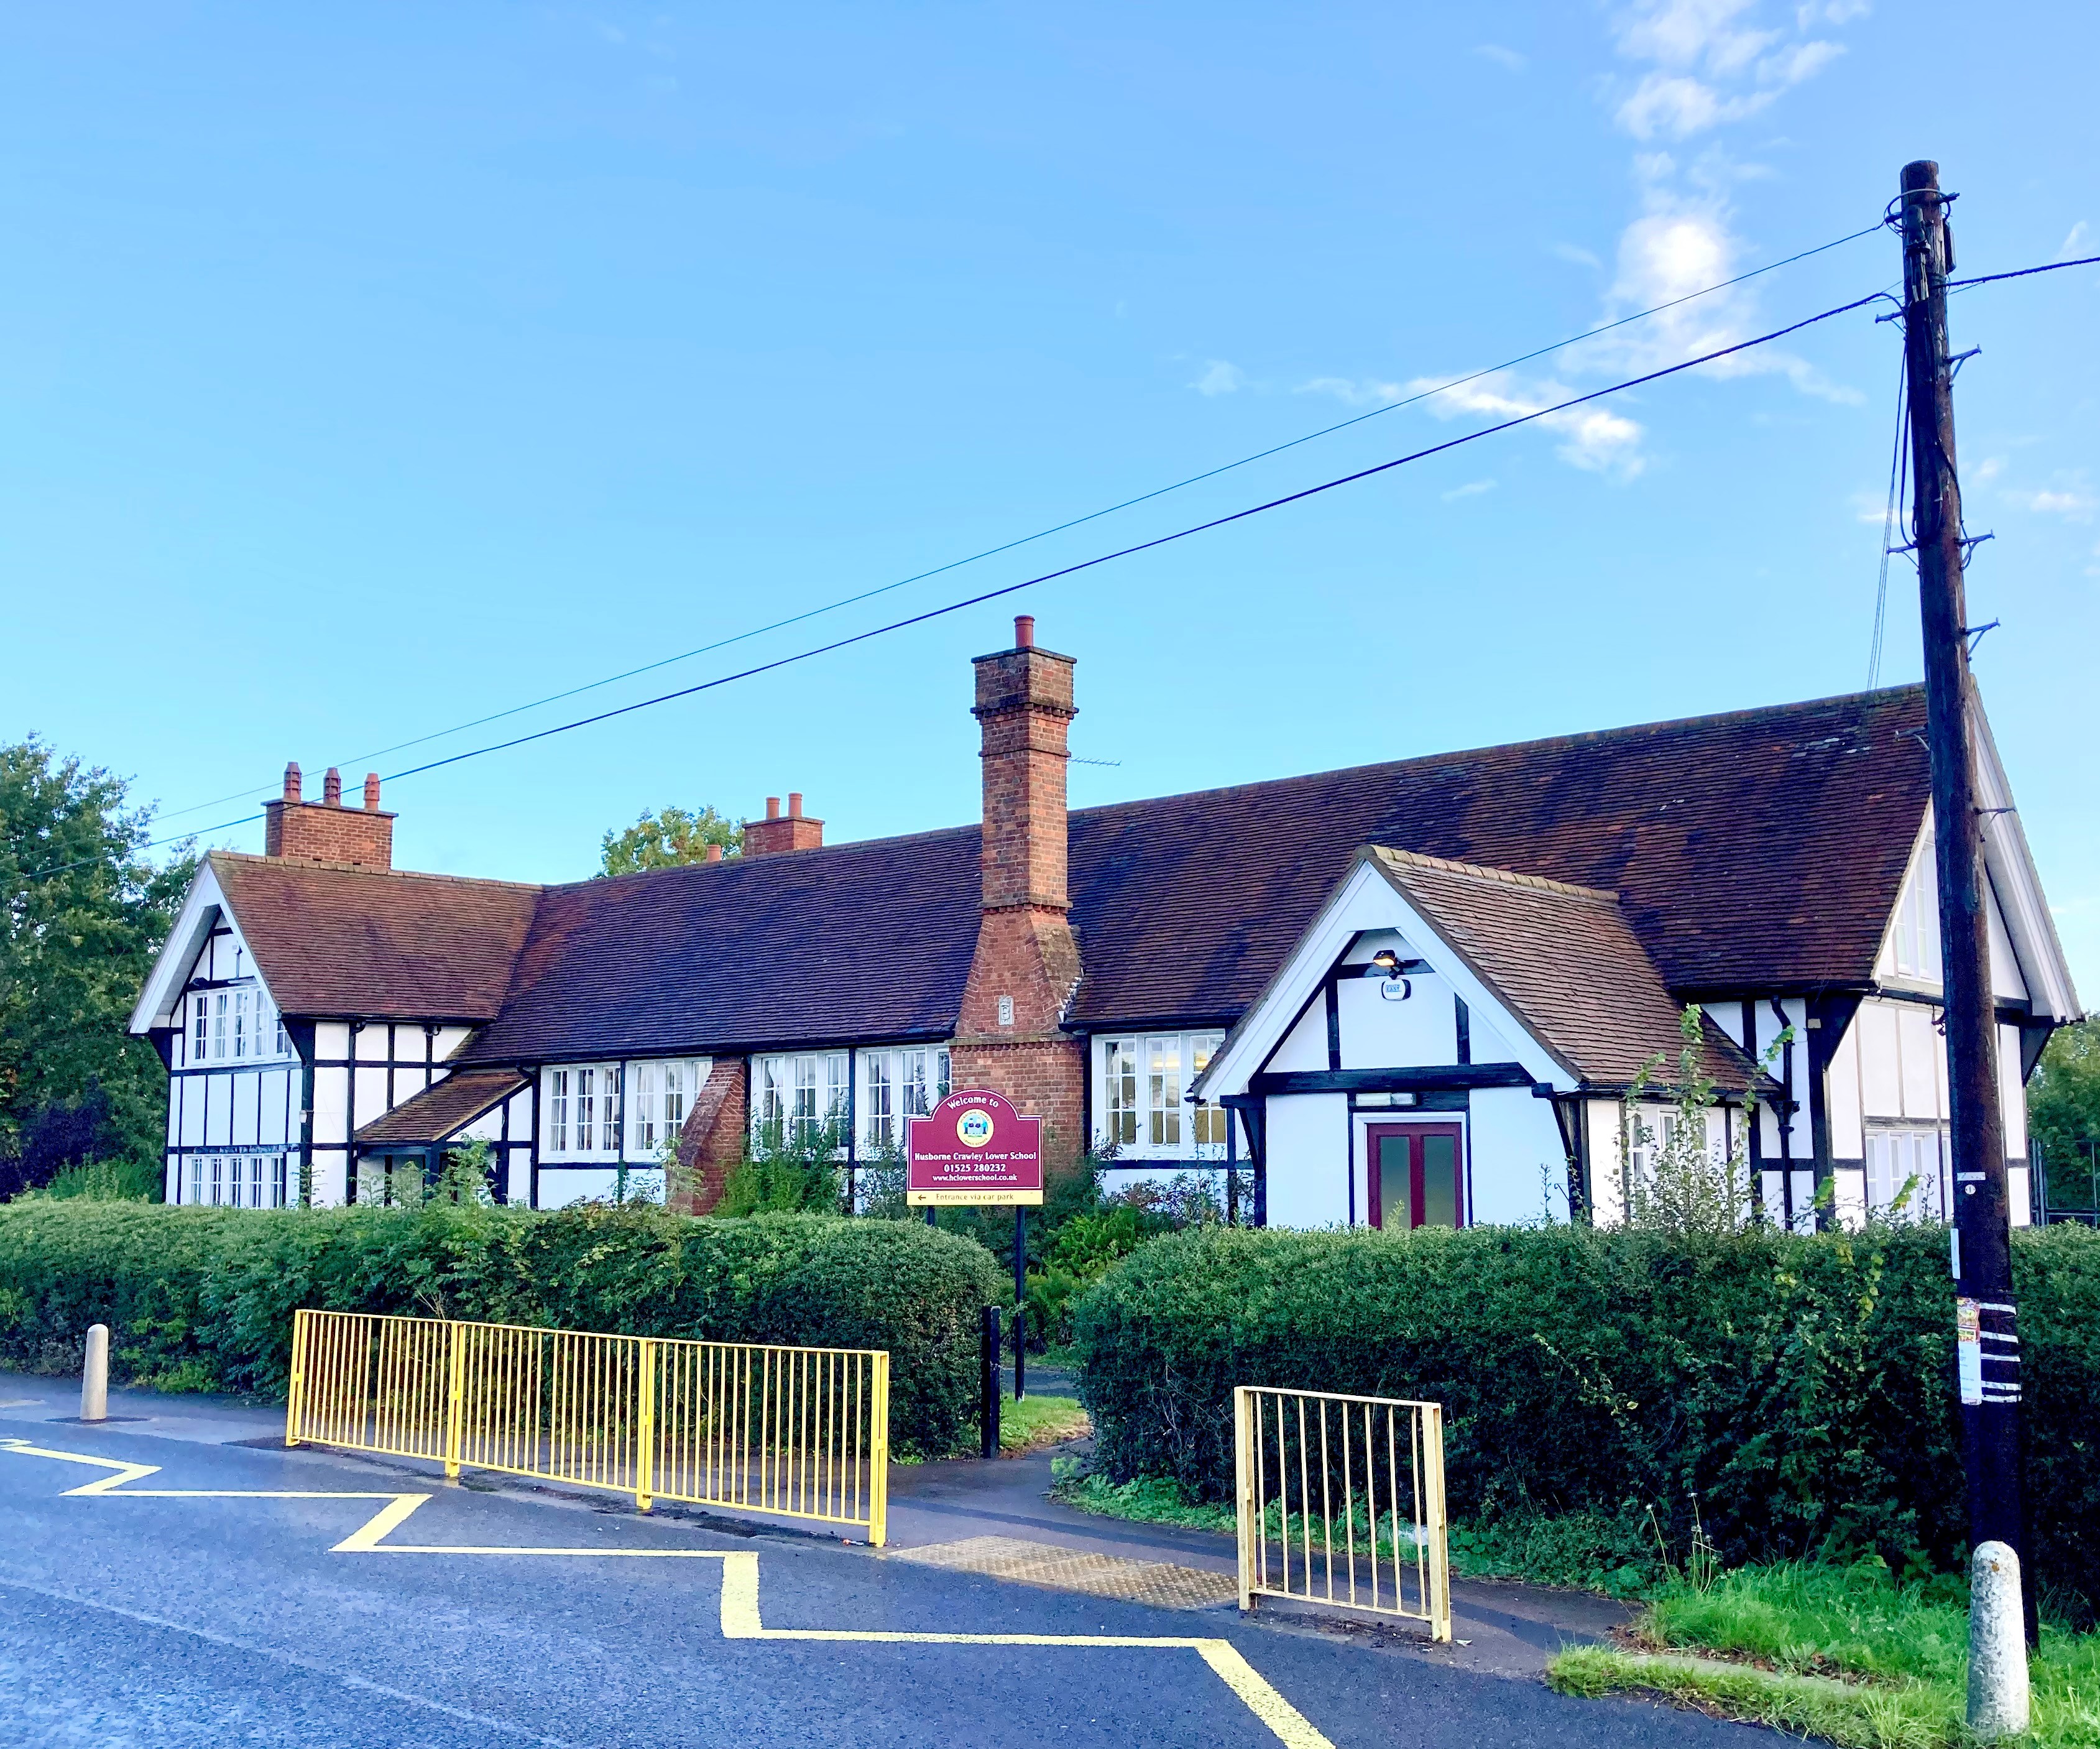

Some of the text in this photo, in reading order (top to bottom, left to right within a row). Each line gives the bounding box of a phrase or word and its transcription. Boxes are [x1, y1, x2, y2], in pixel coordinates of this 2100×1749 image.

[947, 1096, 999, 1110] Welcome to
[914, 1151, 1036, 1161] Husborne Crawley Lower School
[944, 1163, 1006, 1173] 01525 280232
[997, 1193, 1013, 1201] park
